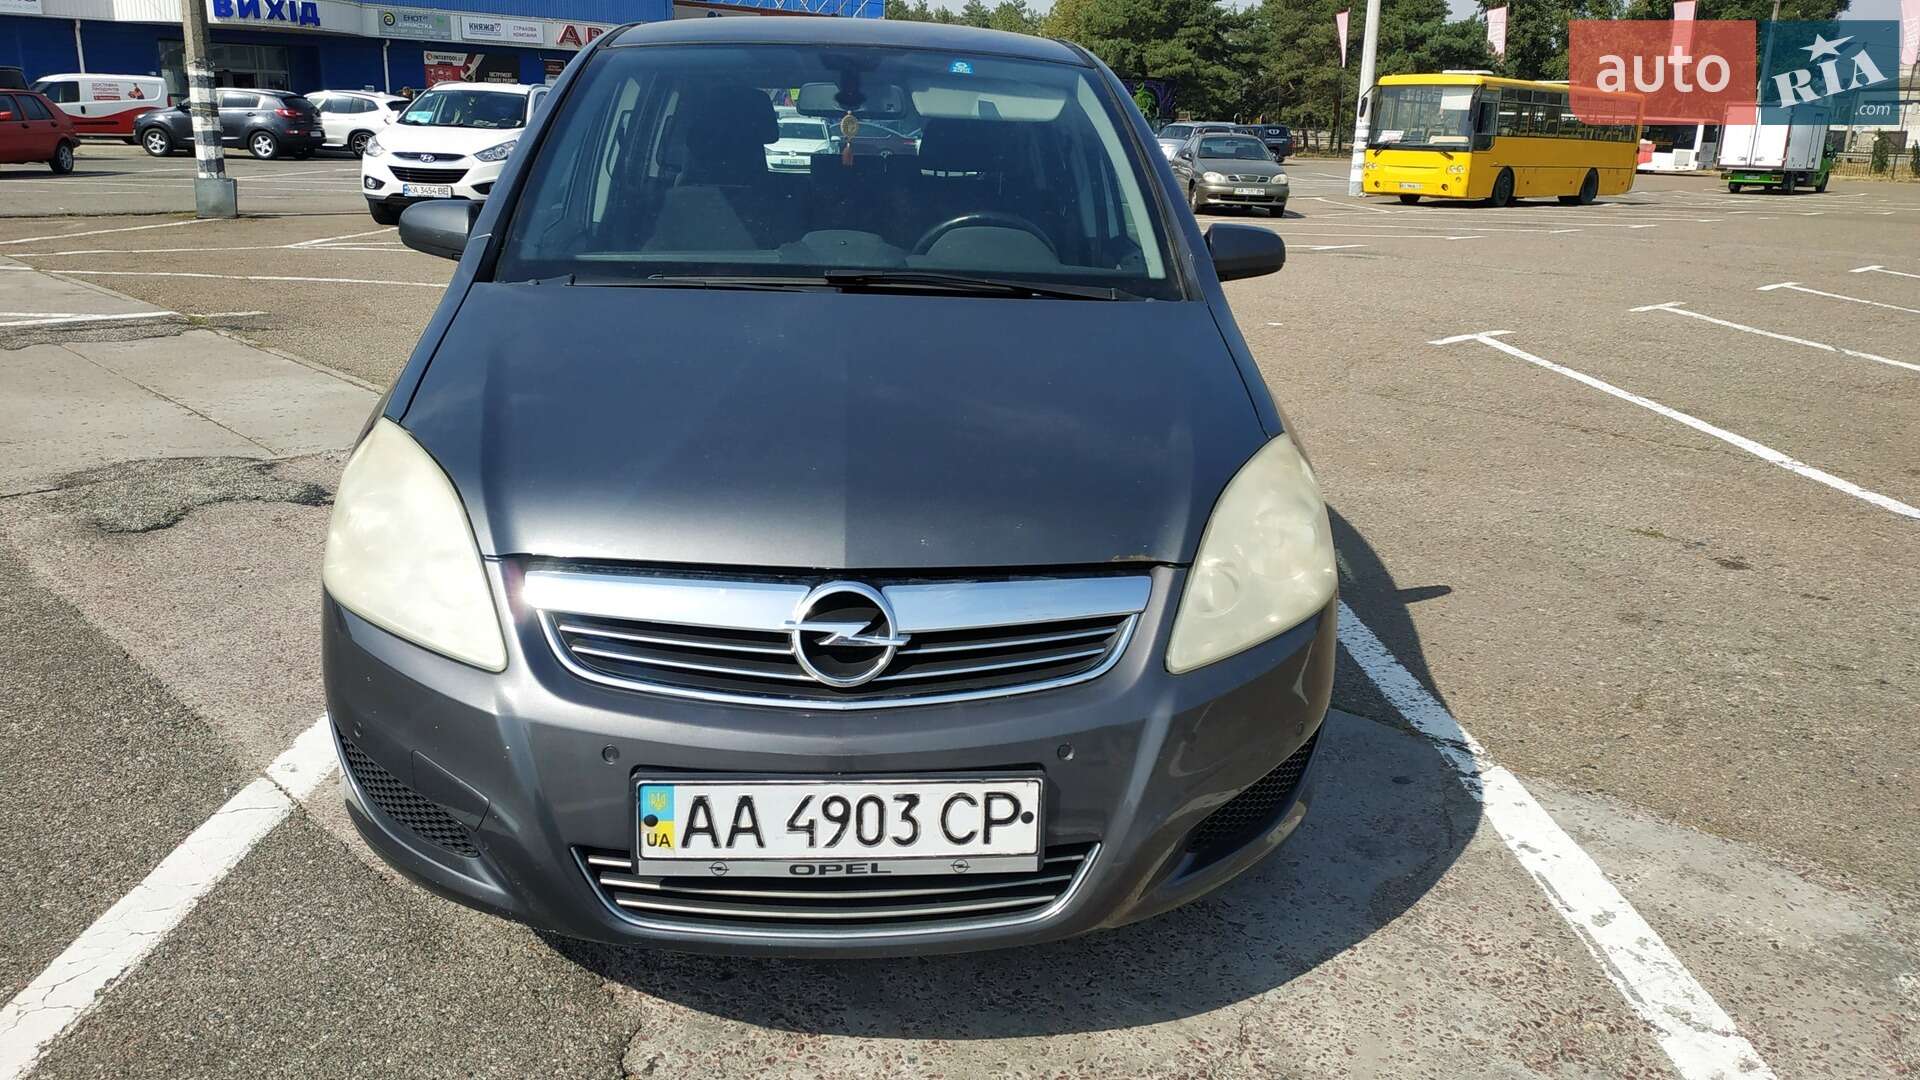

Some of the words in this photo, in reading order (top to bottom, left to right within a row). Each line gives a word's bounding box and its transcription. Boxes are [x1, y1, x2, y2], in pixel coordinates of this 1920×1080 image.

[213, 0, 320, 26] ВИХІД
[680, 794, 766, 849] AA
[786, 793, 921, 849] 4903
[939, 791, 1022, 846] CP
[645, 834, 672, 848] UA
[788, 862, 892, 876] OPEL
